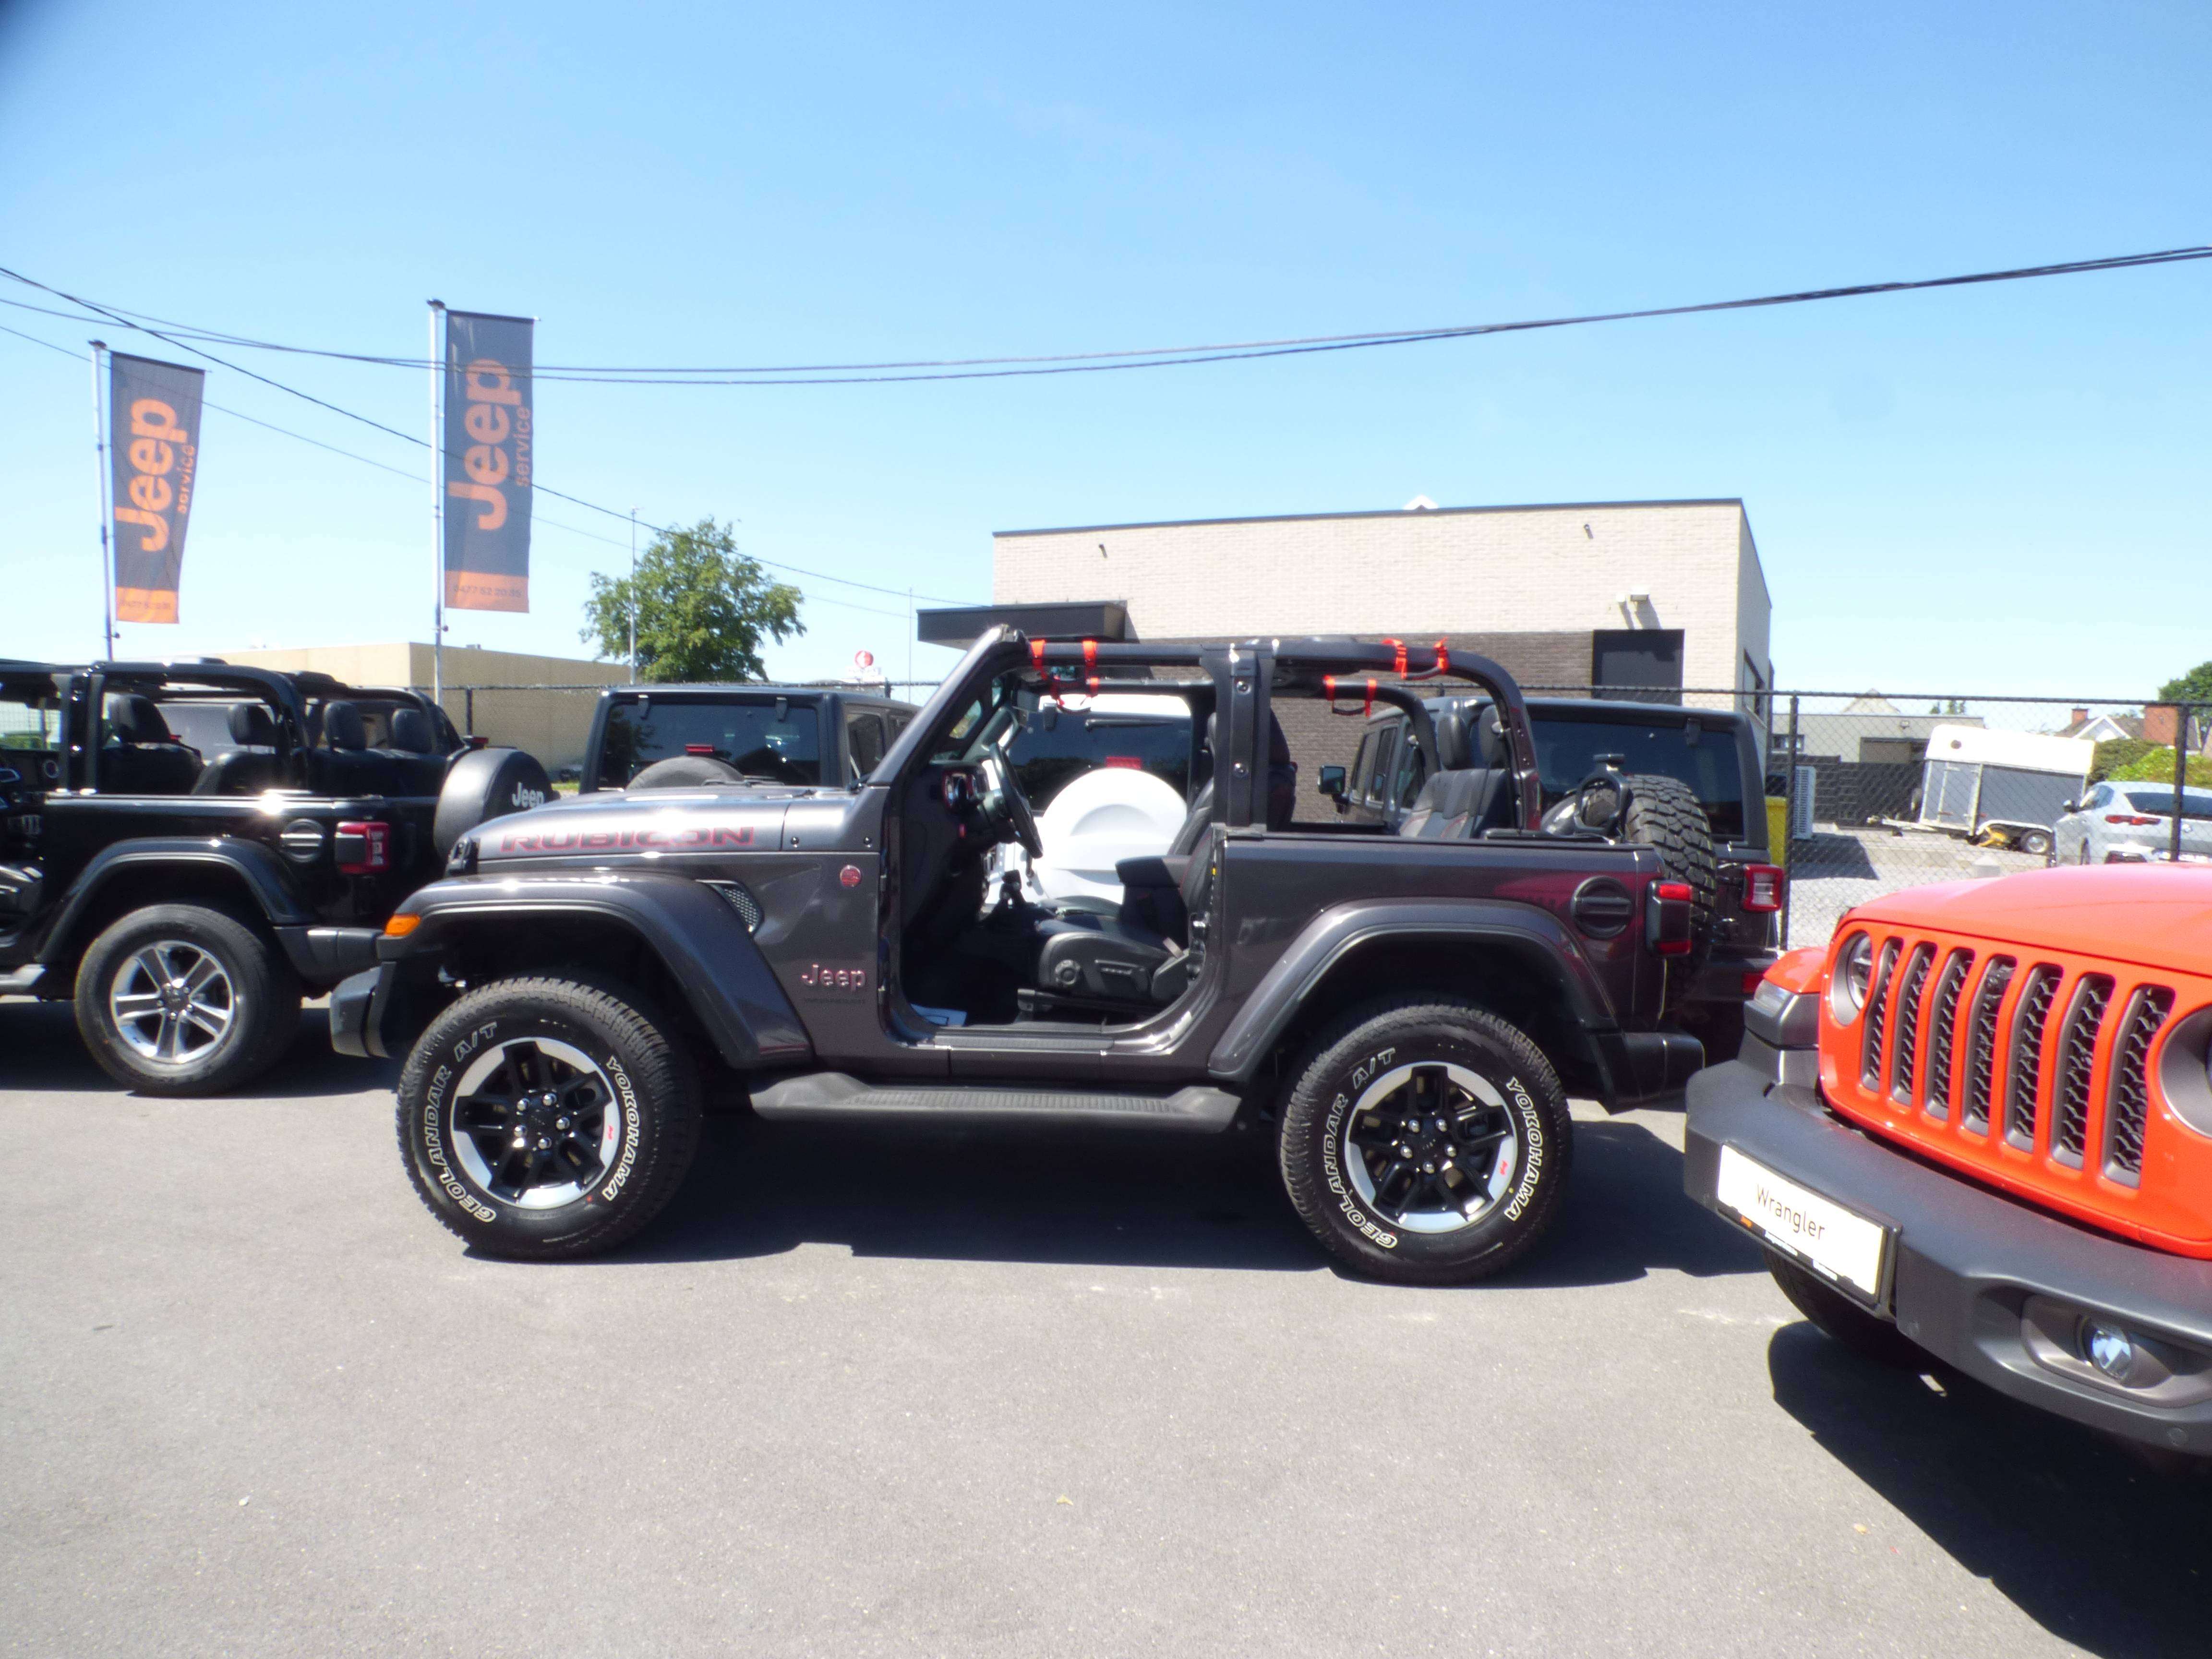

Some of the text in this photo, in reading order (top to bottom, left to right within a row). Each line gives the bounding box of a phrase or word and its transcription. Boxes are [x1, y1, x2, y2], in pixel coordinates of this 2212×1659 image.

[115, 398, 187, 552] Jeep
[177, 445, 195, 515] service
[448, 359, 521, 530] Jeep
[512, 406, 531, 487] service
[500, 826, 755, 853] RUBICON
[801, 963, 867, 992] Jeep
[424, 1021, 498, 1223] GEOLANDAR A/T
[601, 1056, 639, 1201] YOKOHAMA
[1323, 1047, 1398, 1249] GEOLANDAR A/T
[1503, 1076, 1543, 1222] YOKOHAMA
[1755, 1183, 1825, 1240] Wrangler
